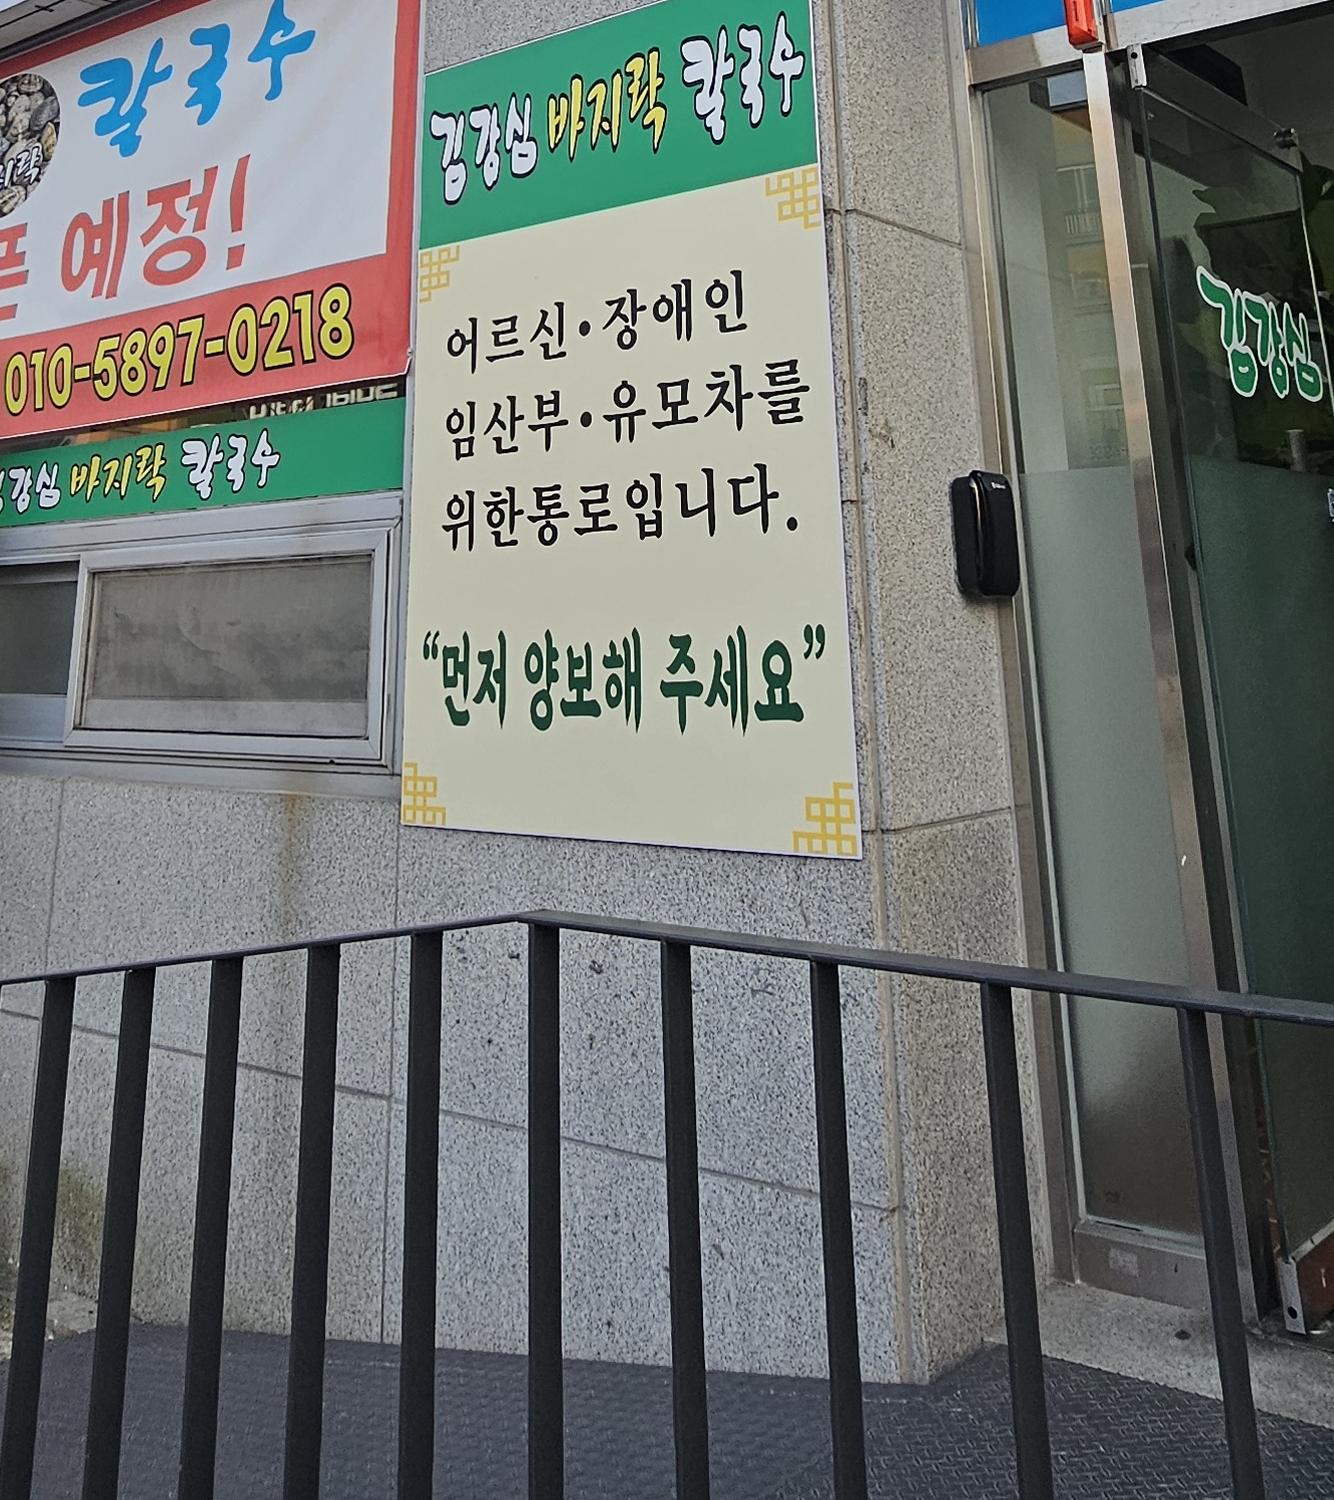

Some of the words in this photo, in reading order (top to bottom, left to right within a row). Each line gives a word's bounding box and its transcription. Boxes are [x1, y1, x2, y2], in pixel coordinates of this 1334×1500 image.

[430, 90, 538, 206] 김강심
[546, 46, 667, 165] 바지락
[680, 11, 805, 145] 칼국수
[61, 153, 252, 299] 예정!
[4, 285, 356, 416] 010-5897-0218
[1195, 264, 1325, 403] 김강심
[69, 440, 167, 504] 바지락
[180, 429, 282, 500] 칼국수
[441, 462, 800, 555] 위한통로입니다.
[523, 625, 644, 735] 양보해
